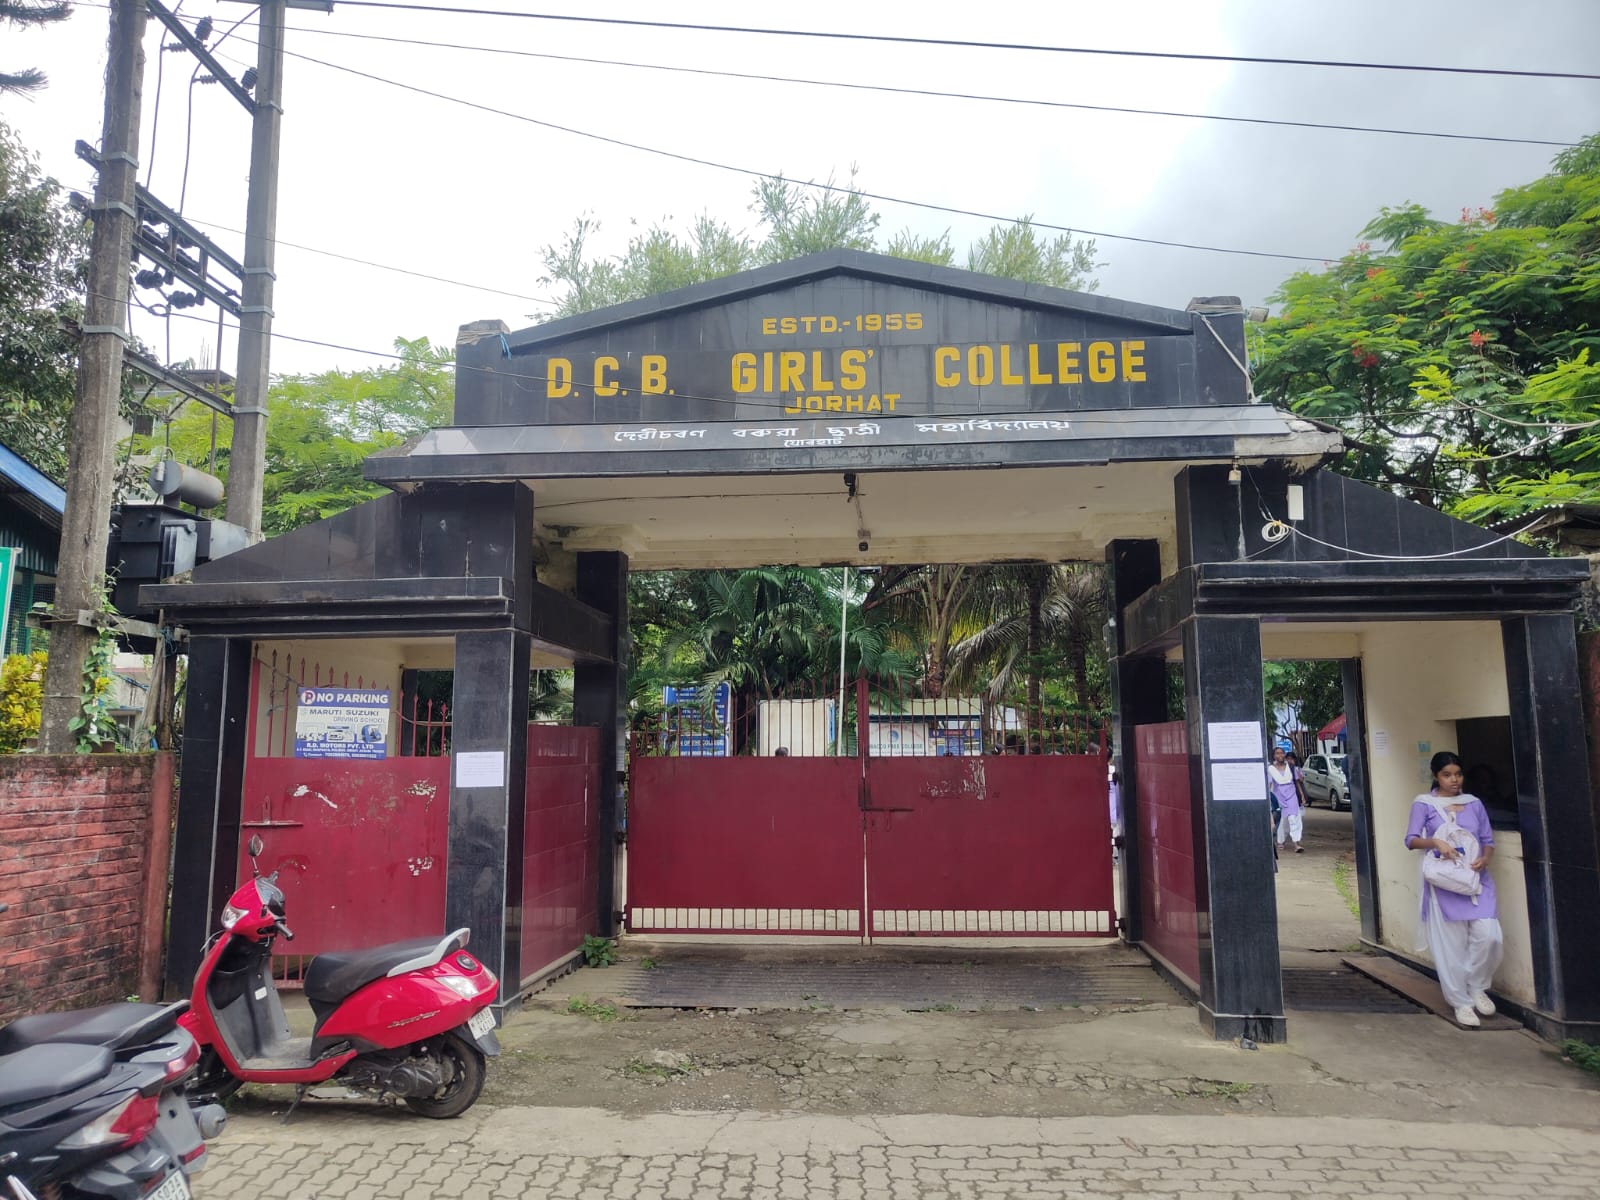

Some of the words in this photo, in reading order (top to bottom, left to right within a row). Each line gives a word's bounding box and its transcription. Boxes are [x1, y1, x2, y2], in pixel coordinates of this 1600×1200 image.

[762, 312, 924, 335] ESTD.-1955
[546, 358, 580, 398] D.
[594, 356, 628, 396] C.
[641, 354, 675, 395] B.
[731, 349, 874, 393] GIRLS'
[934, 340, 1147, 388] COLLEGE
[784, 394, 901, 415] JORHAT
[316, 693, 334, 702] NO
[336, 693, 389, 704] PARKING
